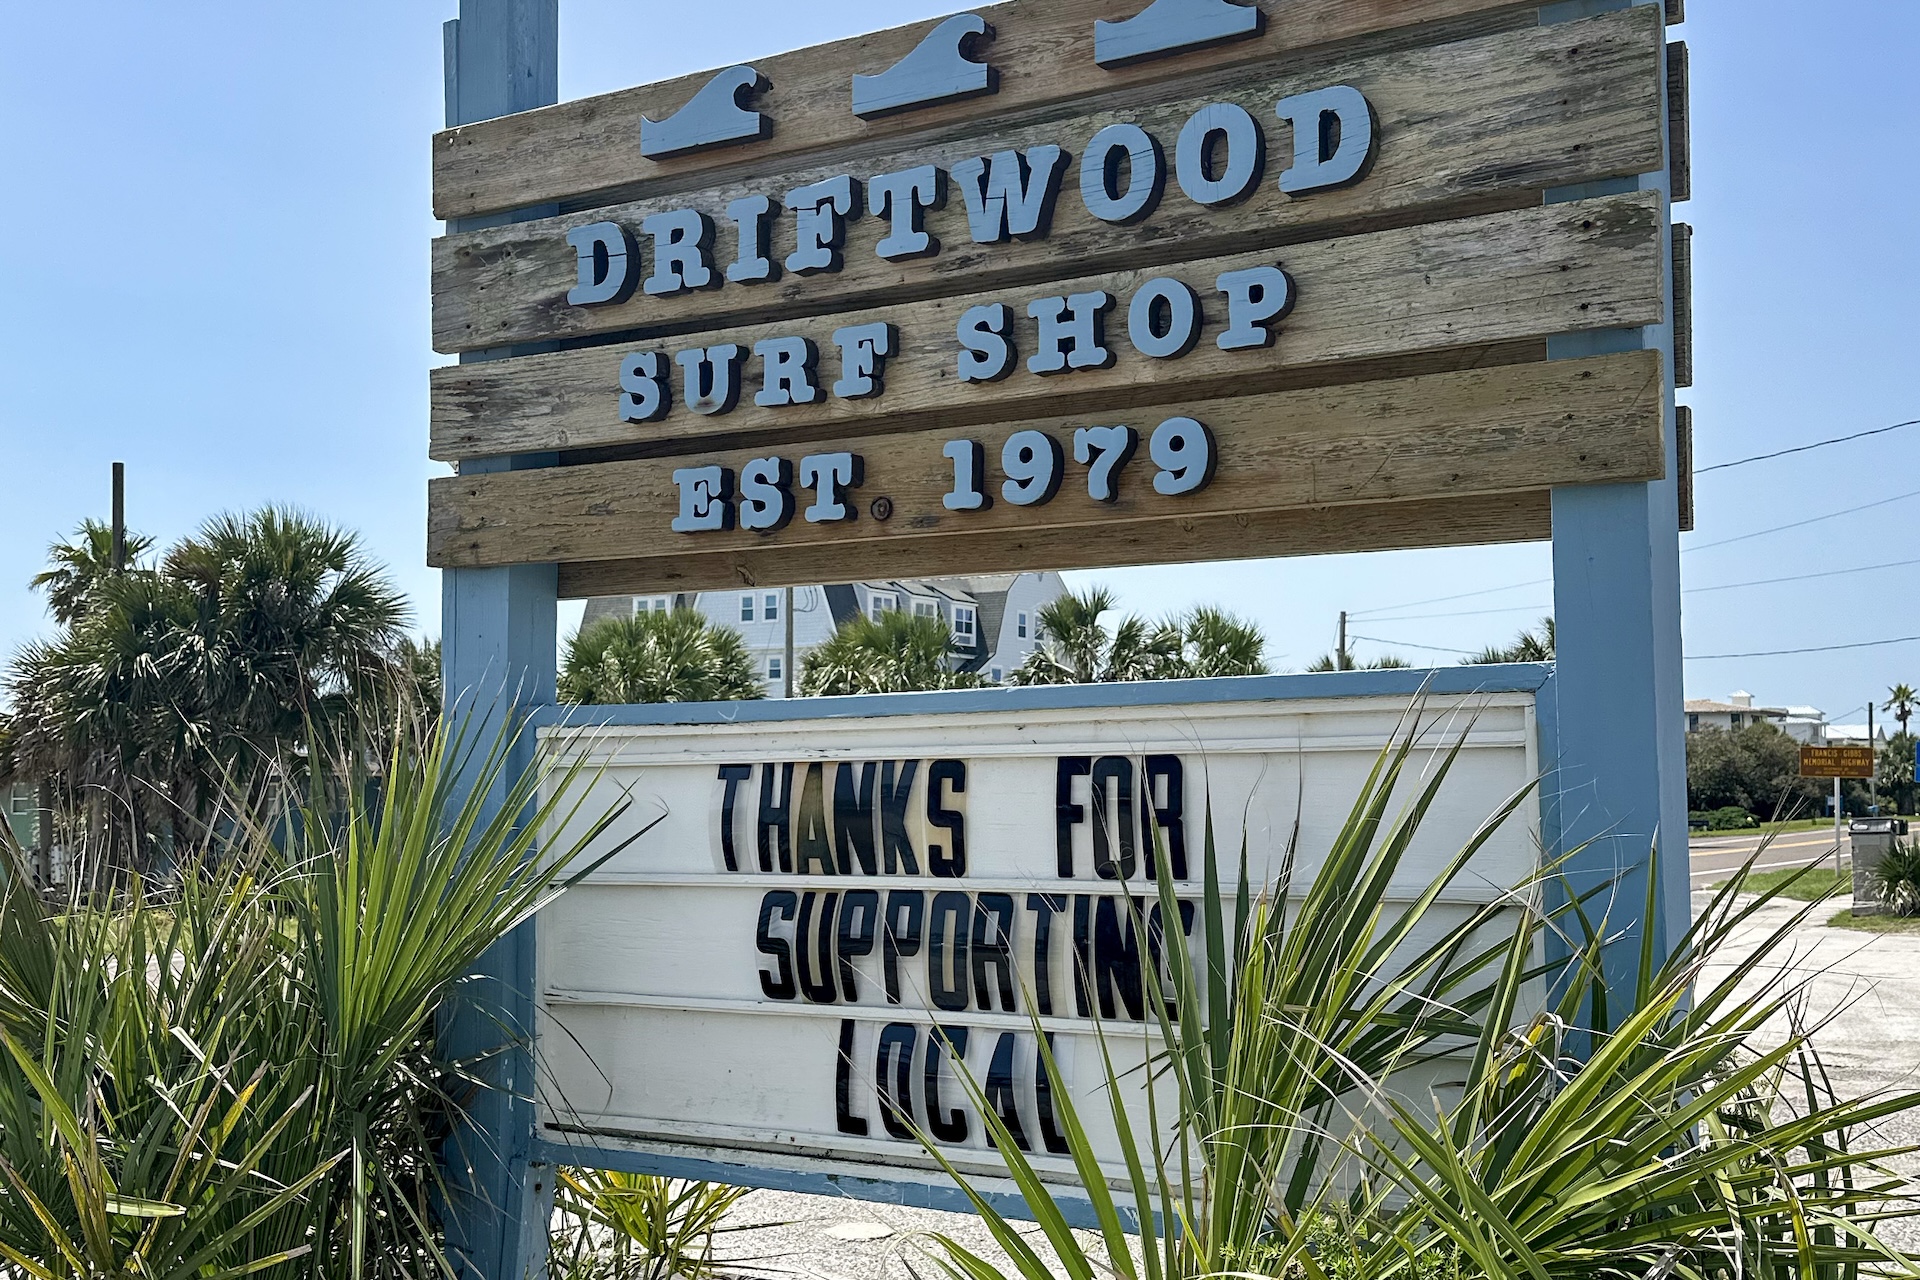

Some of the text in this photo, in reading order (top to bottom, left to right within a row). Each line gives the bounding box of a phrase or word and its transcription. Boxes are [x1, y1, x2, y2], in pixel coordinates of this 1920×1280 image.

[566, 85, 1374, 306] DRIFTWOOD
[619, 266, 1293, 423] SURF SHOP
[943, 417, 1212, 511] 1979
[717, 754, 1189, 881] THANKS FOR
[1803, 758, 1870, 766] MEMORIAL HIGHWAY
[835, 1019, 1074, 1155] LOCAL
